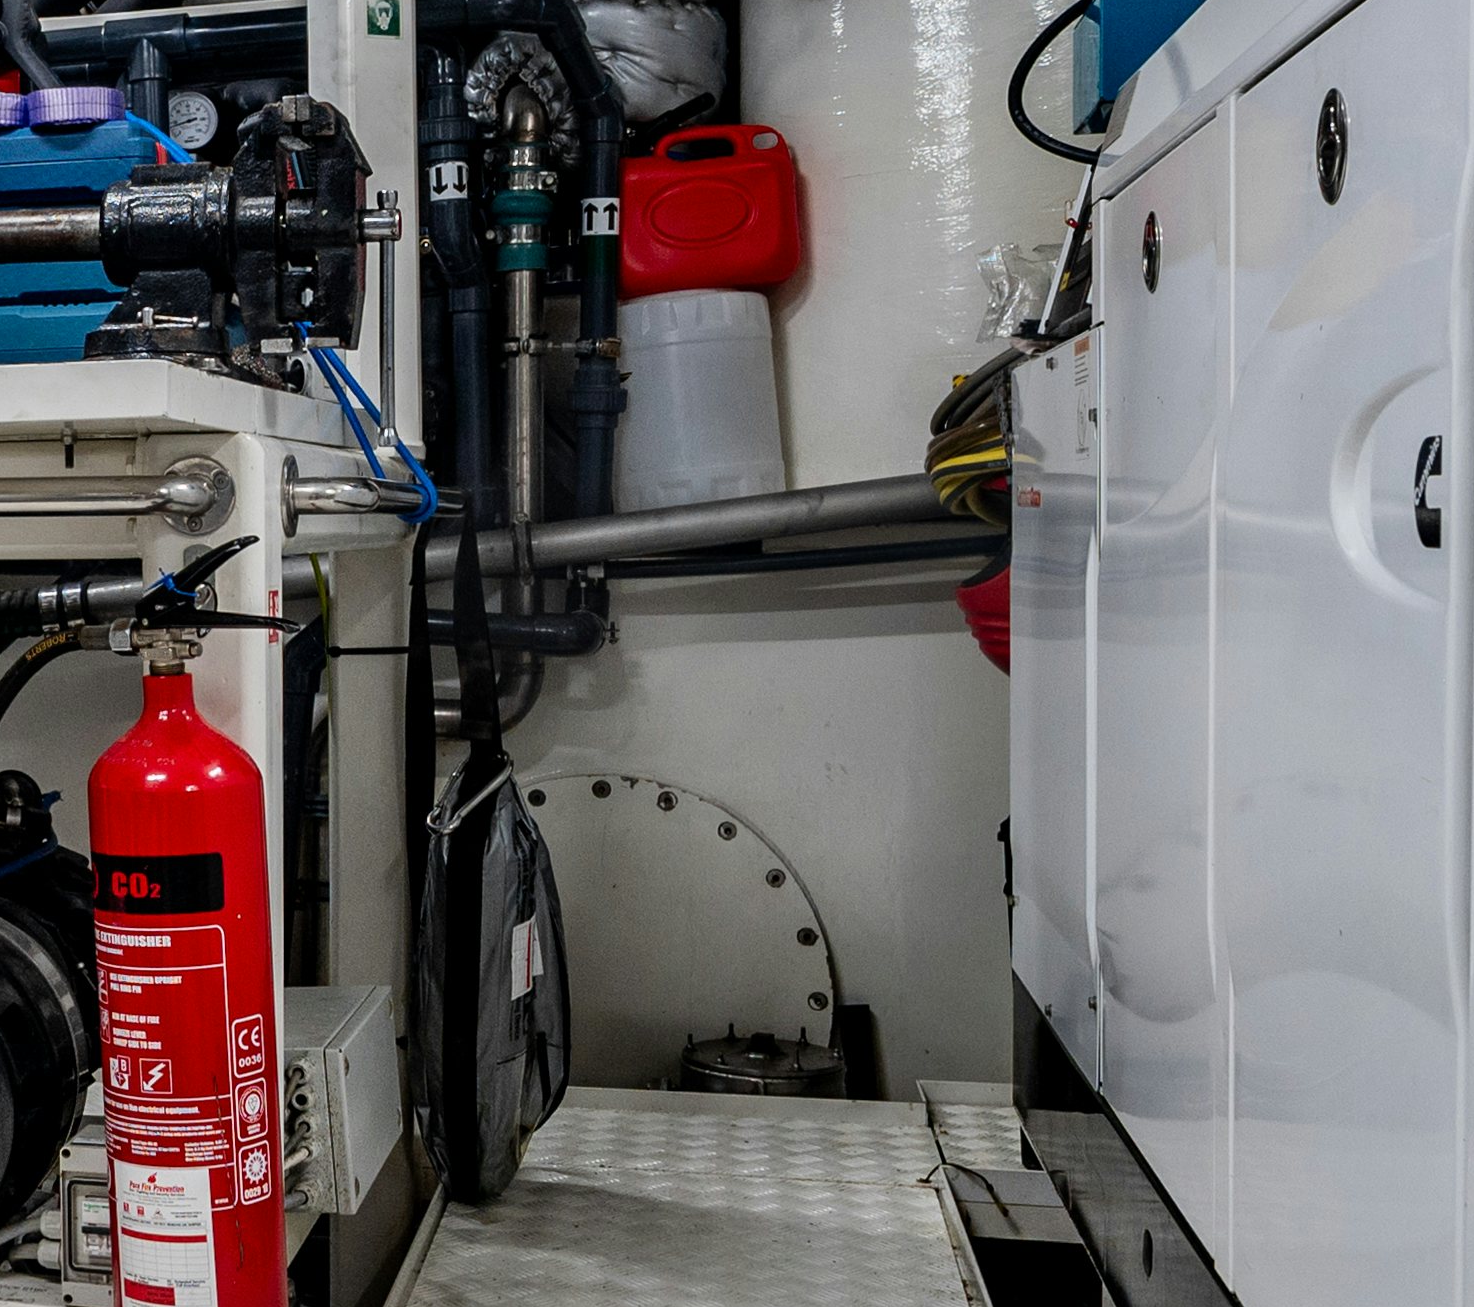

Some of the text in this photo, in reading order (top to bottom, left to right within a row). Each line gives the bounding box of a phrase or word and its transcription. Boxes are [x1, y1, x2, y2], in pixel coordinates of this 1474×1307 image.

[25, 634, 66, 661] ROBERTS
[111, 871, 161, 898] CO2
[100, 931, 172, 948] EXTINGUISHER
[238, 1053, 262, 1068] 0036
[153, 1183, 185, 1193] Prevention
